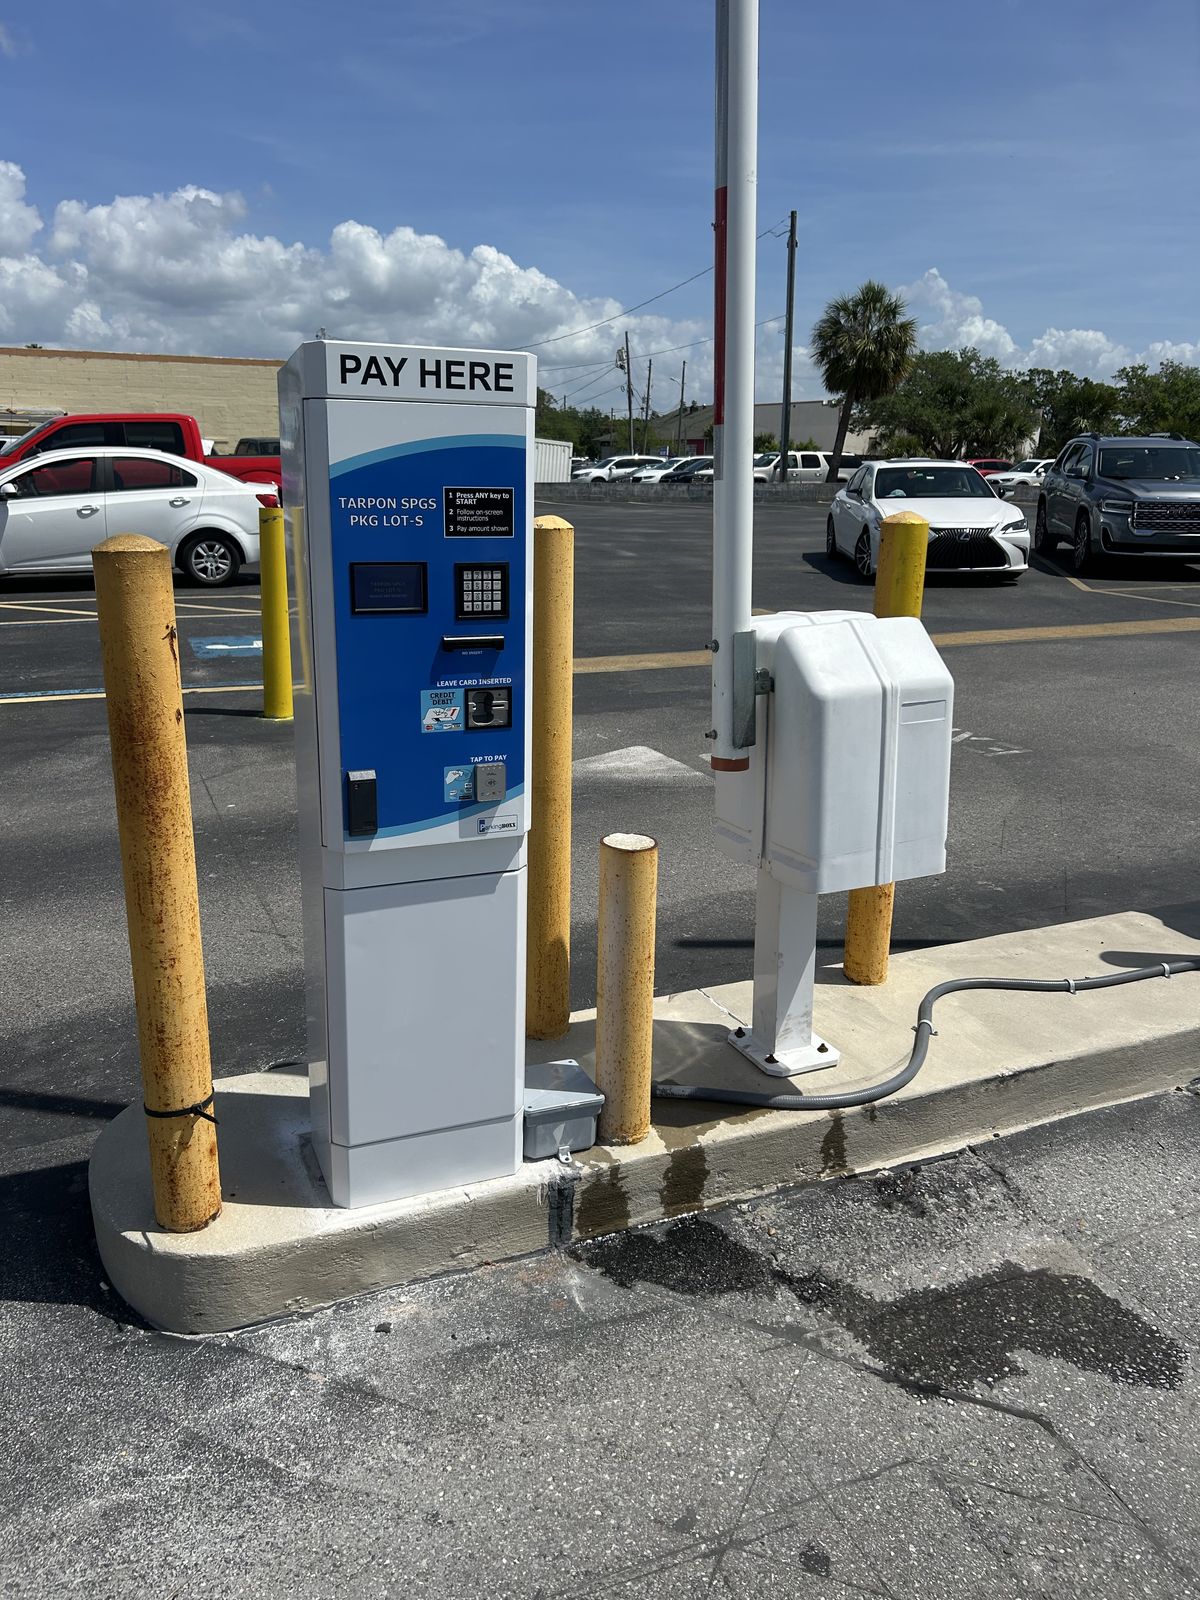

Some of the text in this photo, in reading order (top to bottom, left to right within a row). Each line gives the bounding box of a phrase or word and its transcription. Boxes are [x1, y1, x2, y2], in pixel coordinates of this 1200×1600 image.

[339, 353, 514, 392] PAY HERE
[489, 492, 502, 500] key
[338, 497, 437, 509] TARPON SPGS
[350, 515, 424, 527] PKG LOT-S
[456, 525, 467, 533] Pay
[479, 677, 512, 685] INSERTED
[430, 691, 456, 699] CREDIT
[432, 698, 453, 706] DEBIT
